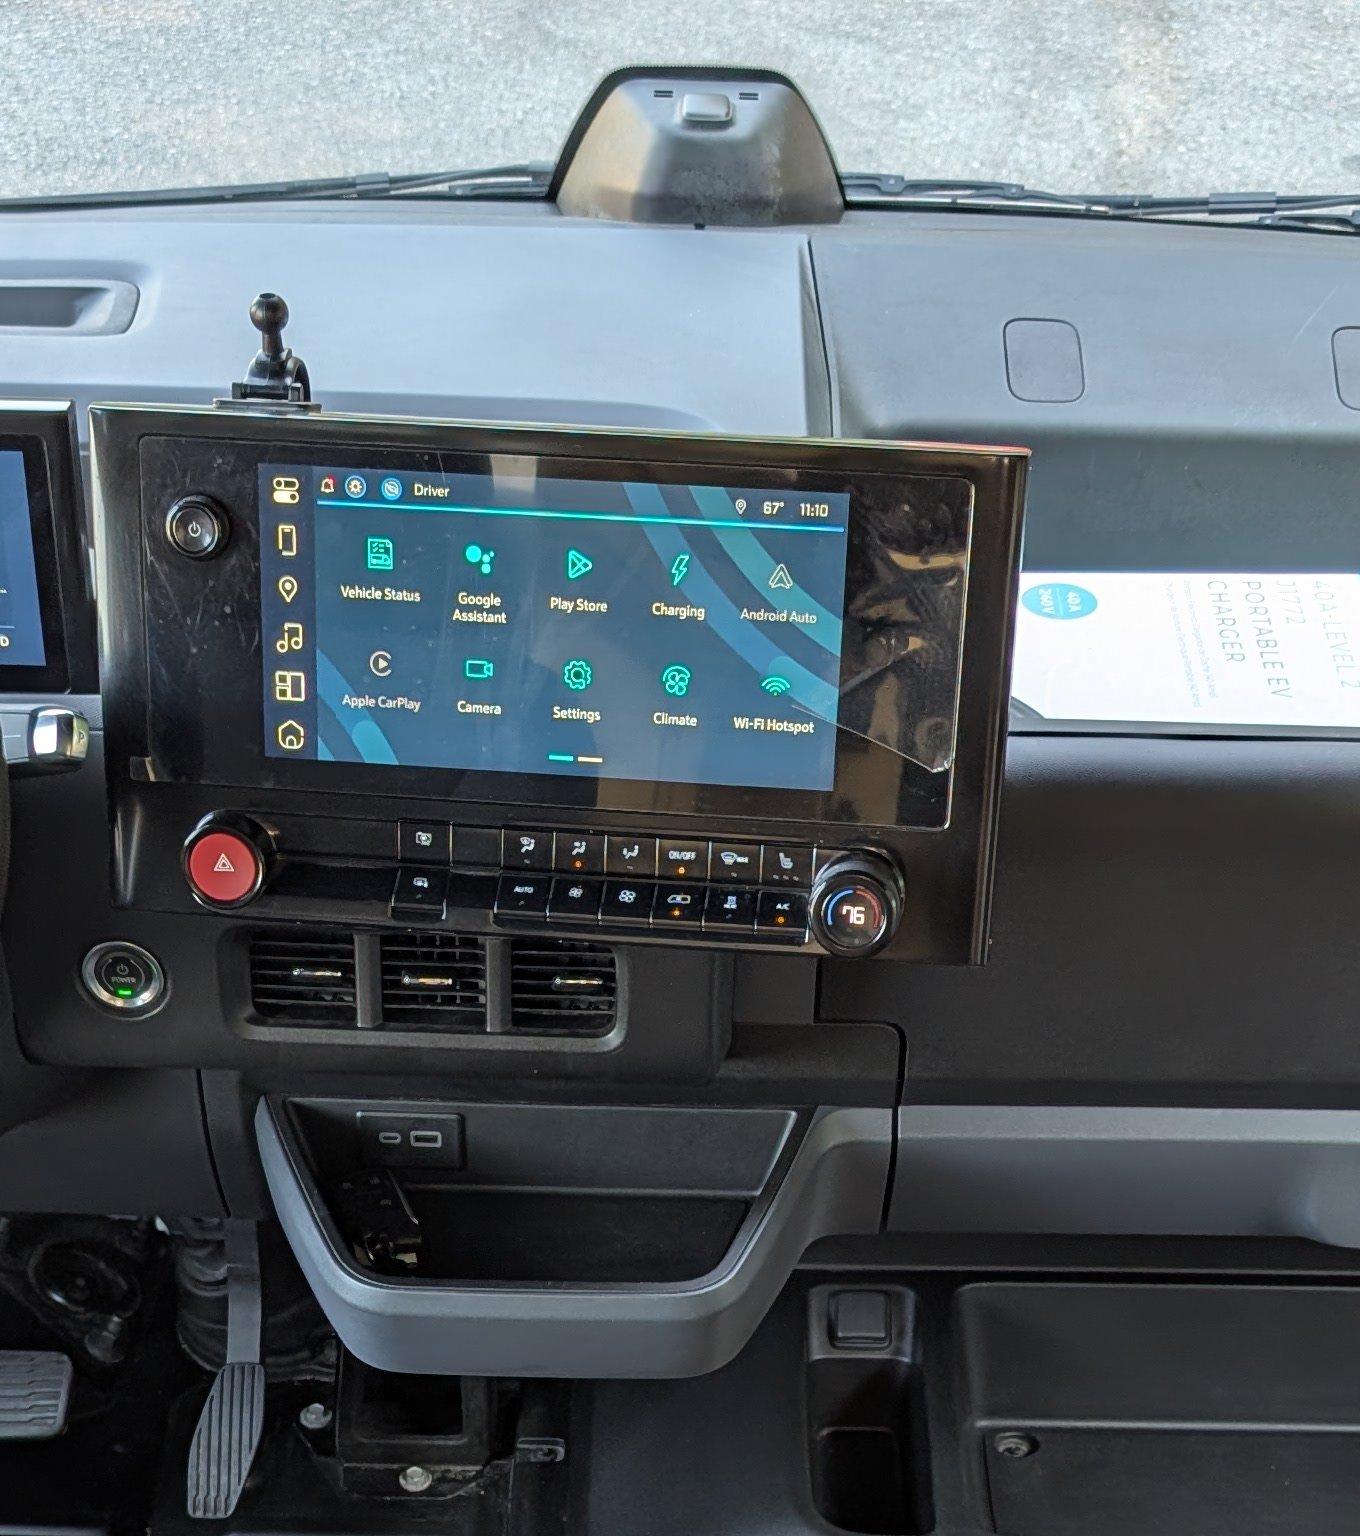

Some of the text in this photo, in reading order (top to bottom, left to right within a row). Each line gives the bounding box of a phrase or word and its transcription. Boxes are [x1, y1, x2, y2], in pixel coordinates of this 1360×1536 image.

[414, 483, 451, 498] Driver
[799, 503, 829, 517] 11:10
[340, 585, 421, 603] Vehicle Status
[457, 592, 501, 610] Google
[550, 597, 608, 614] Play Store
[1275, 581, 1307, 625] J1772
[452, 609, 507, 624] Assistant
[652, 603, 706, 621] Charging
[740, 608, 818, 624] Android Auto
[1207, 580, 1246, 663] CHARGER
[0, 634, 10, 647] D
[1242, 581, 1293, 699] PORTABLE EV
[342, 694, 422, 713] Apple CarPlay
[457, 701, 502, 715] Camera
[552, 706, 601, 723] Settings
[653, 712, 698, 727] Climate
[733, 717, 815, 736] Wi-Fi Hotspot
[668, 850, 697, 861] ON/OFF
[513, 885, 534, 894] AUTO
[842, 905, 866, 925] 76
[111, 976, 137, 984] POWER
